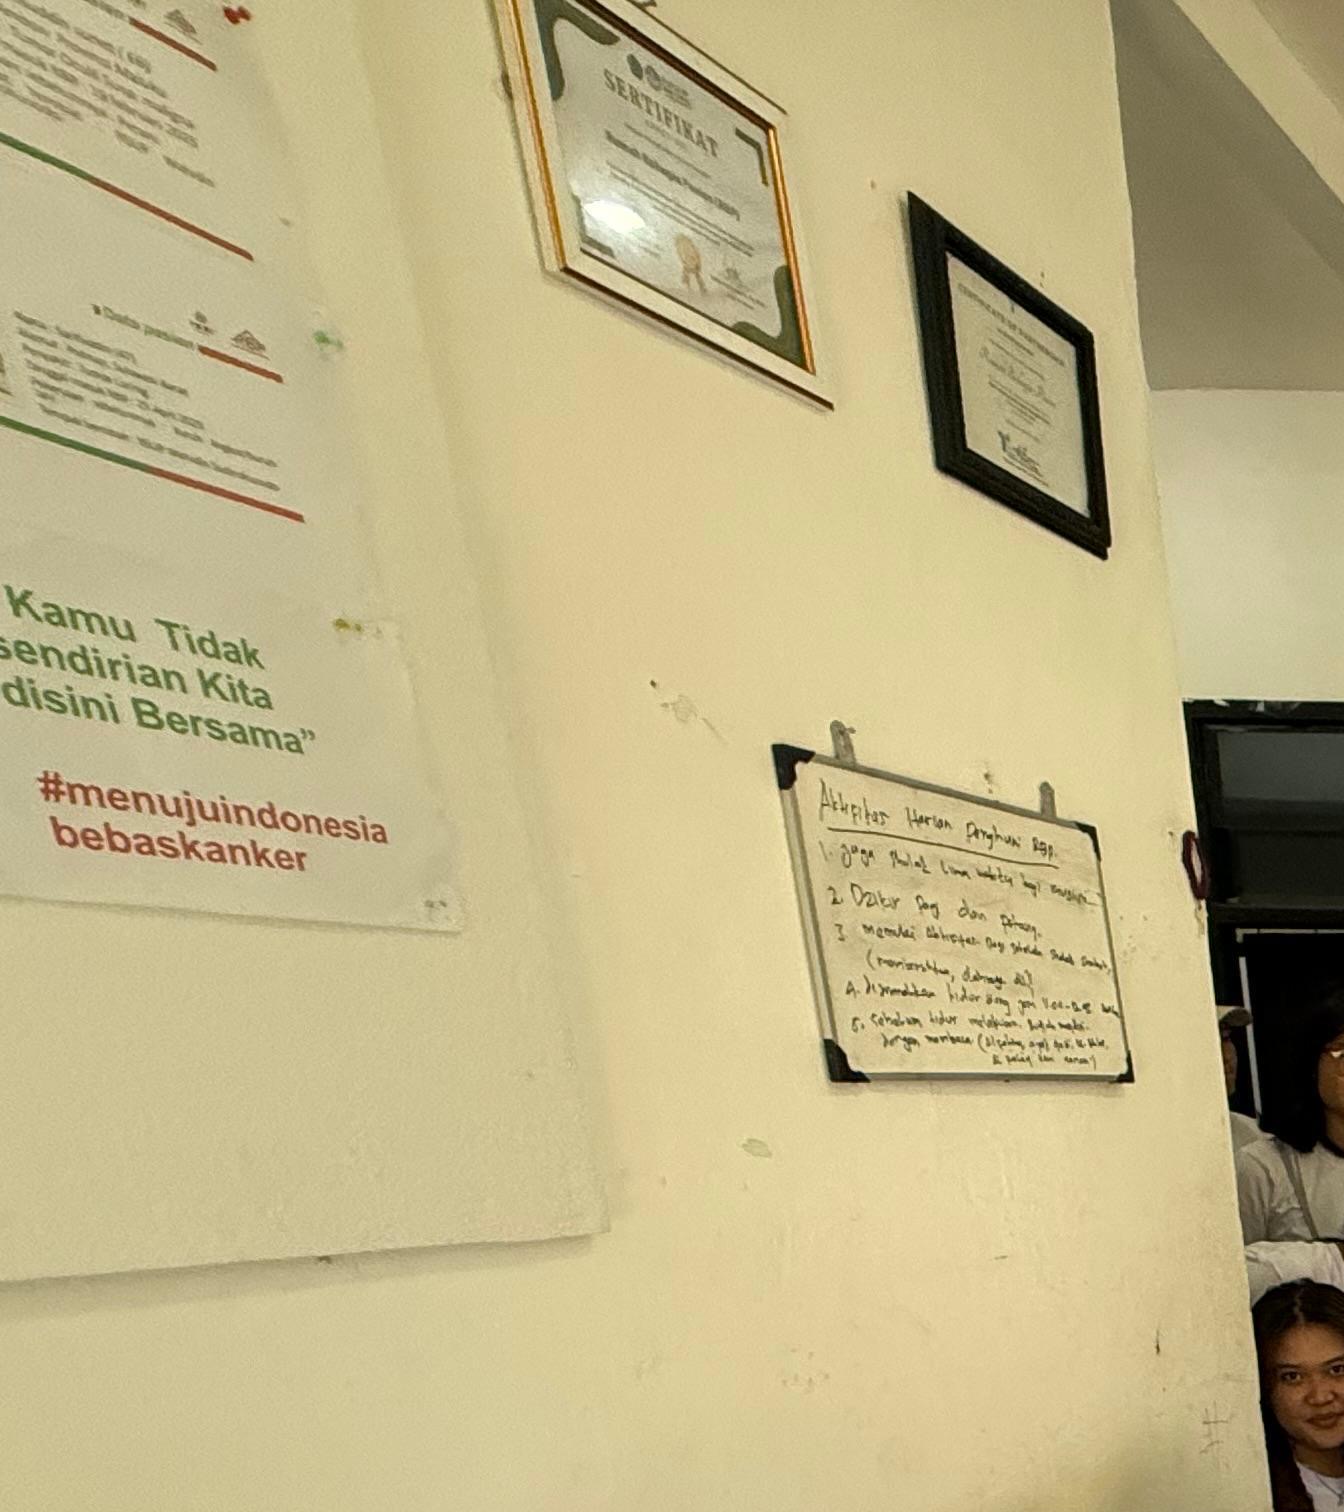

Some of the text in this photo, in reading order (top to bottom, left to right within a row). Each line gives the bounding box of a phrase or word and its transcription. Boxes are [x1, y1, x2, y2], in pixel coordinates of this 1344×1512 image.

[603, 68, 718, 158] SERTIFIKAT
[3, 584, 266, 670] Kamu Tidak
[2, 675, 121, 726] disini
[196, 668, 274, 711] Kita
[36, 769, 389, 846] #menujuindonesia
[49, 816, 308, 873] bebaskanker
